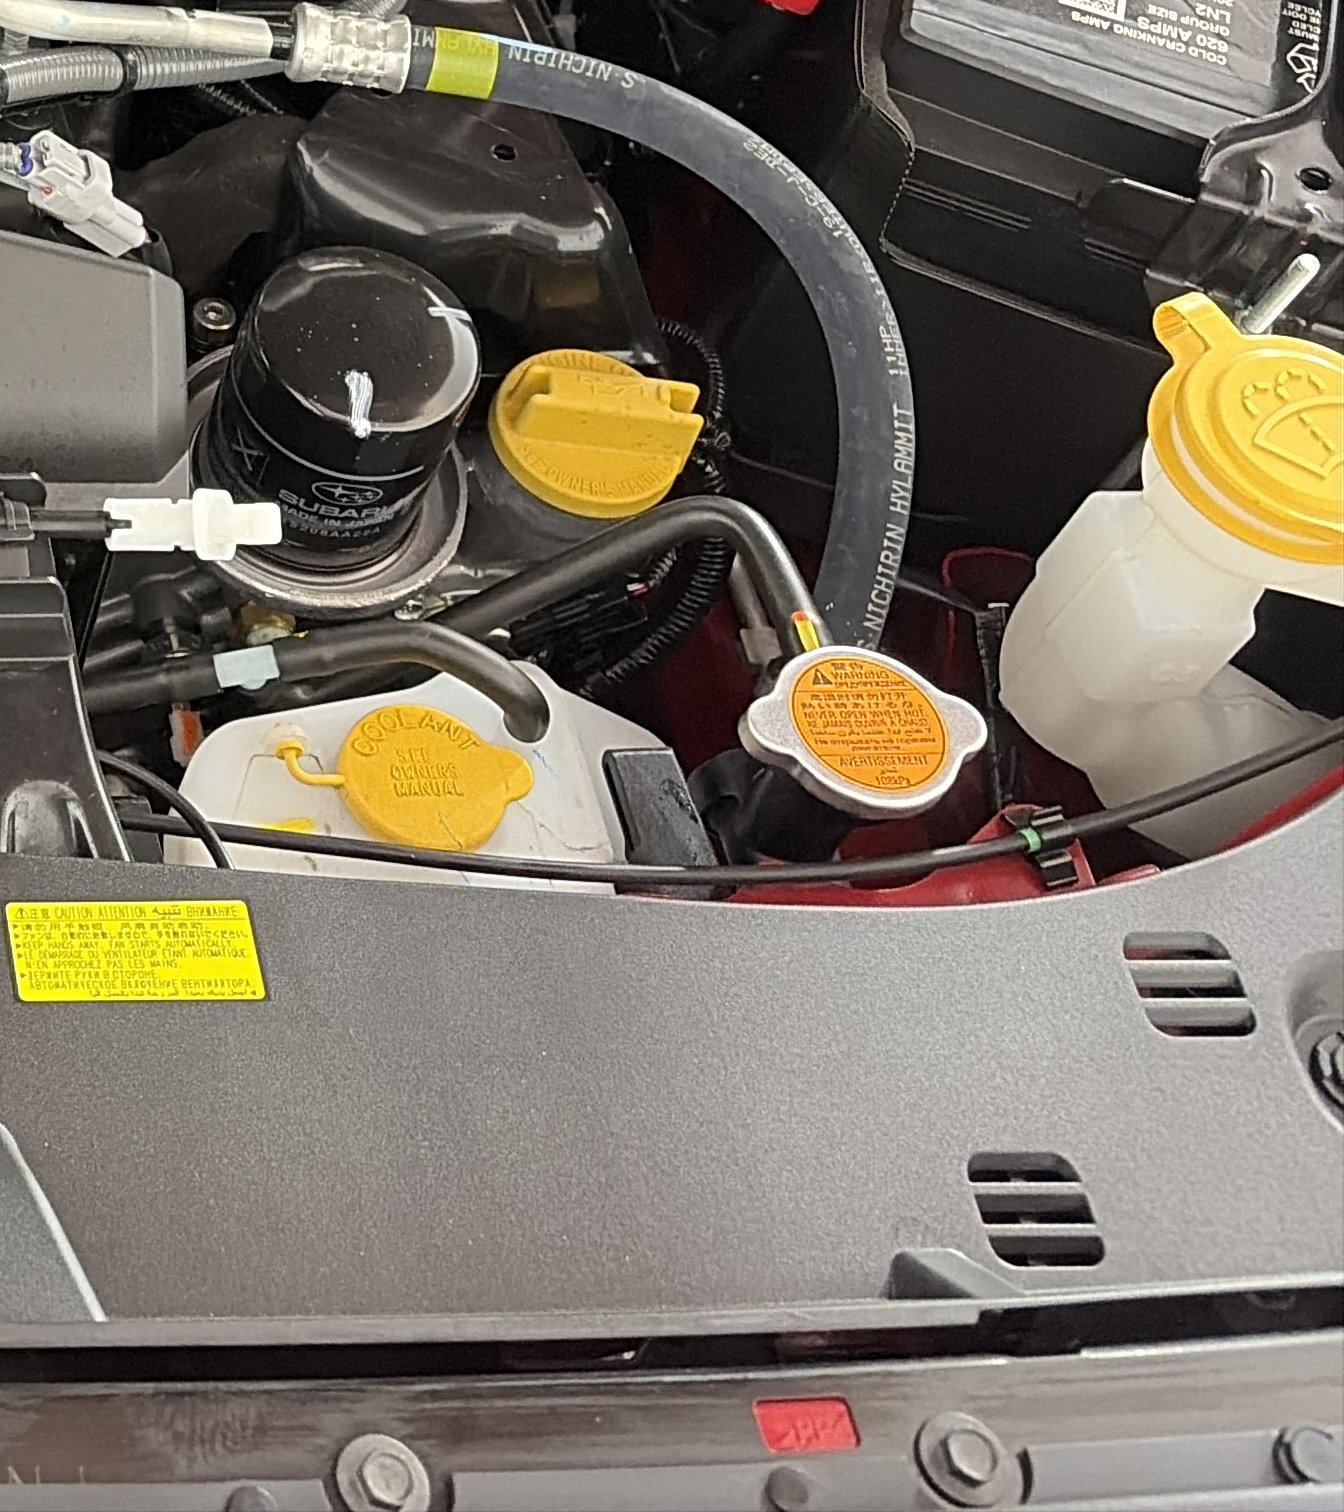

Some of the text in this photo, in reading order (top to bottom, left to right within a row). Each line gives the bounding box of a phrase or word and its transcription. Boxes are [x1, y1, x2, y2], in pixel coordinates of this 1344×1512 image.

[1147, 4, 1230, 37] GROUP SIZE
[1195, 3, 1231, 24] LN2
[1071, 10, 1227, 66] COLD CRANKING AMPS
[1136, 15, 1229, 53] 620 AMPS
[831, 670, 890, 681] WARNING
[351, 709, 481, 758] COOLANT
[839, 755, 928, 768] AVERTISSEMENT
[393, 780, 465, 798] MANUAL
[54, 906, 94, 919] CAUTION
[98, 905, 147, 919] ATTENTION
[22, 940, 43, 949] KEEP
[109, 940, 126, 949] FAN
[129, 940, 161, 949] STARTS
[103, 949, 157, 959] VENTILATEUR
[53, 959, 102, 969] APPROCHEZ
[106, 959, 123, 969] PAS
[128, 959, 145, 968] LES
